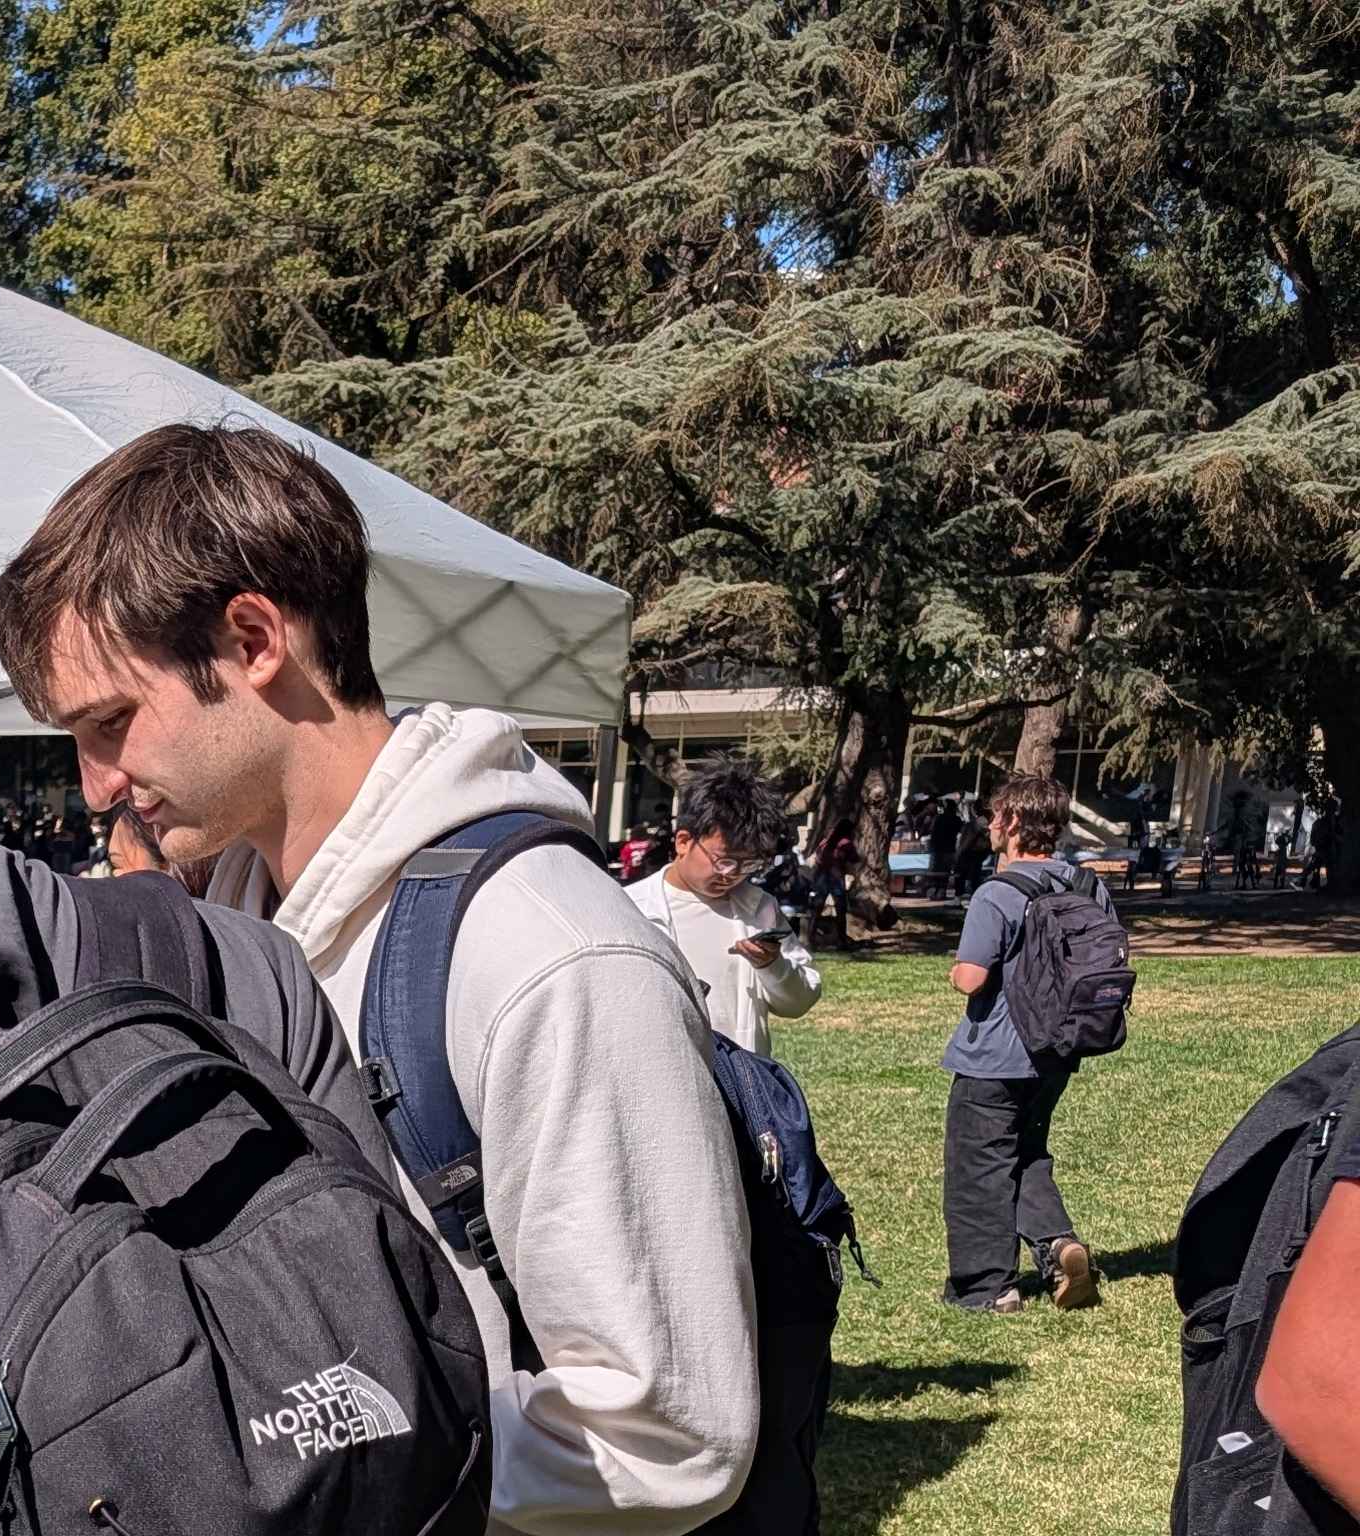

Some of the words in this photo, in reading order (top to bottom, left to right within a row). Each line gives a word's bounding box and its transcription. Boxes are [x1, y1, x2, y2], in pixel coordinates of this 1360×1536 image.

[281, 1366, 348, 1403] THE
[248, 1389, 359, 1446] NORTH
[293, 1415, 367, 1460] FACE
